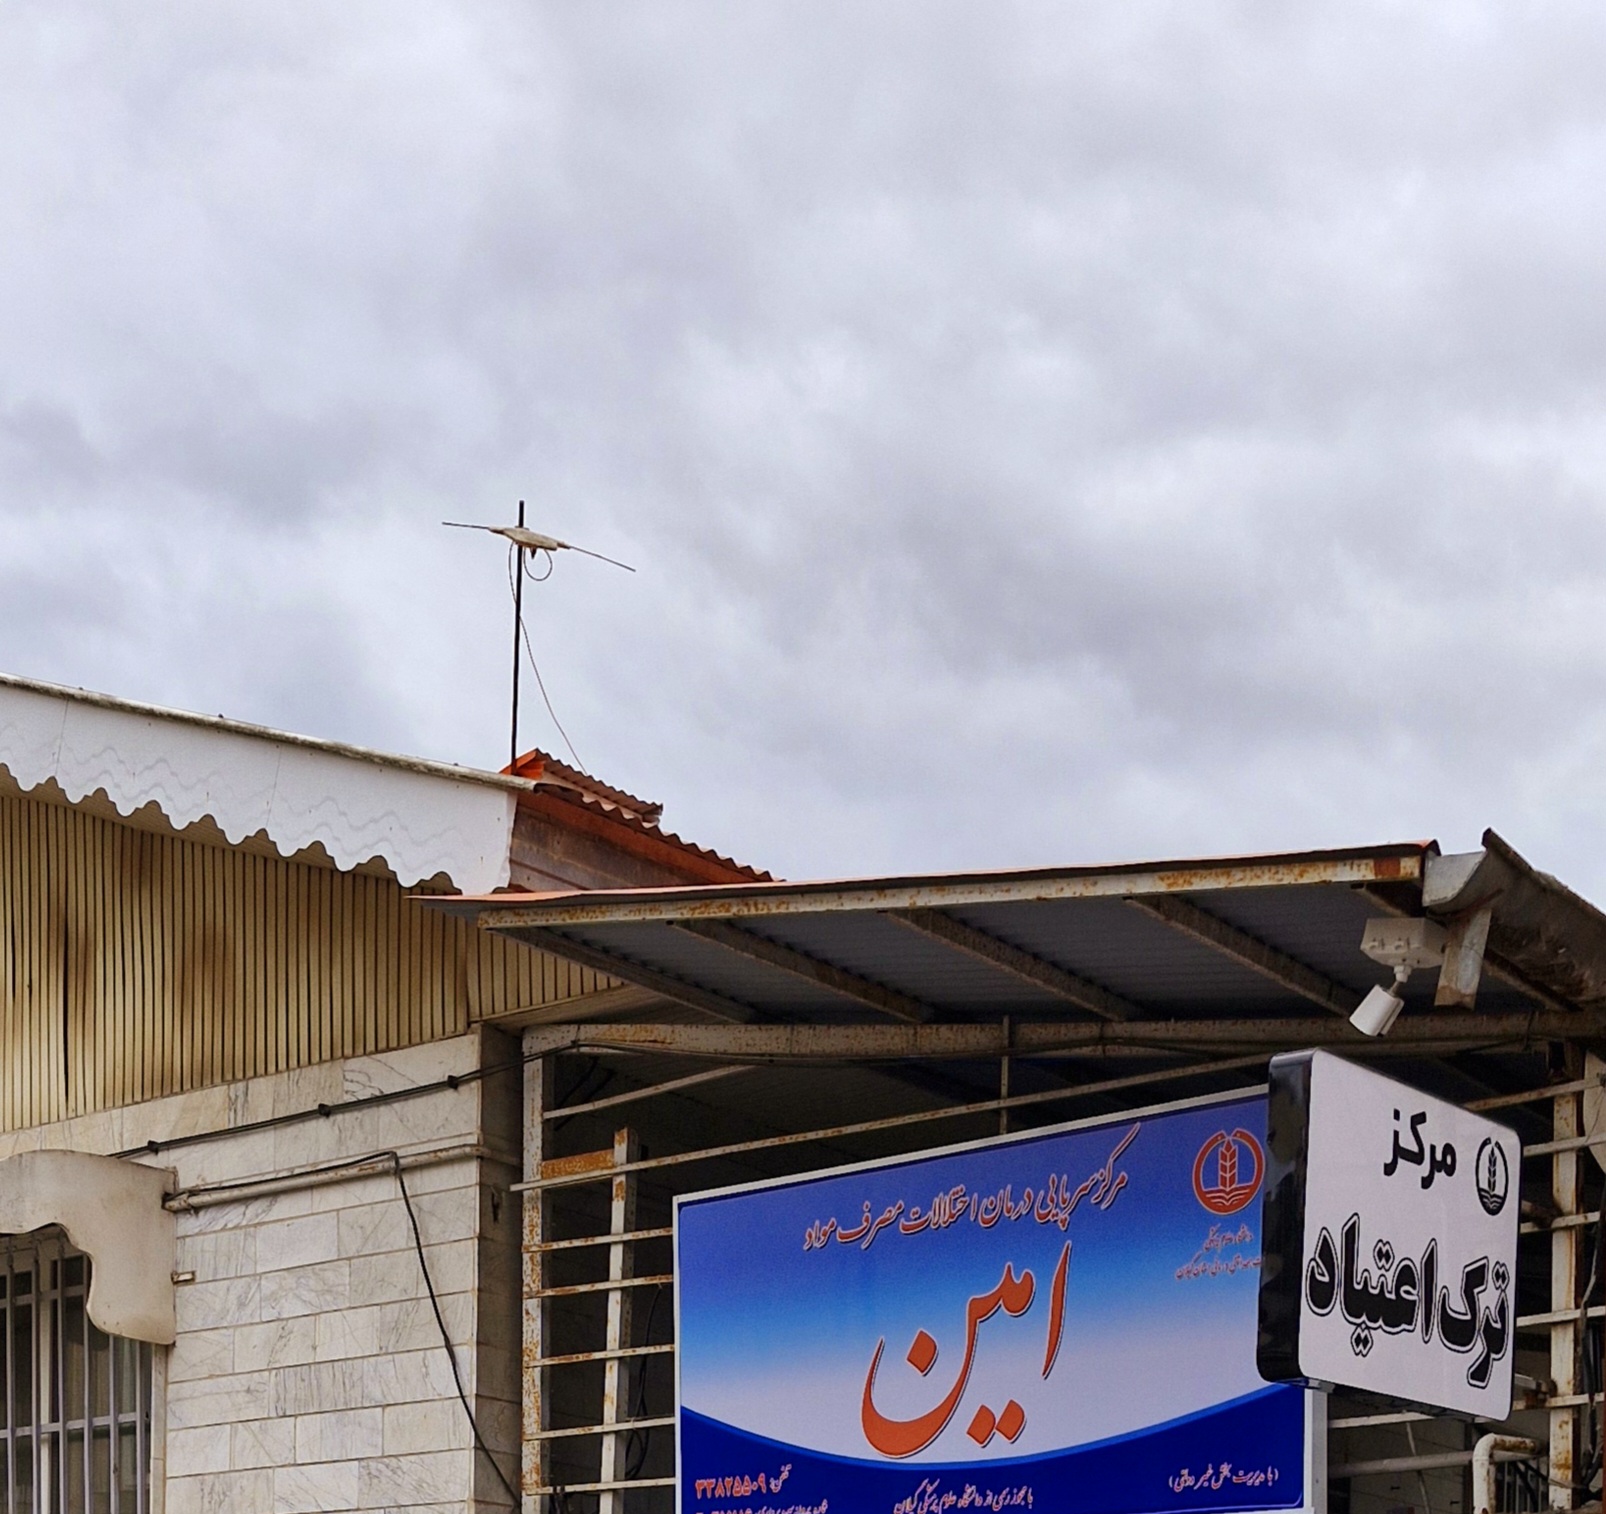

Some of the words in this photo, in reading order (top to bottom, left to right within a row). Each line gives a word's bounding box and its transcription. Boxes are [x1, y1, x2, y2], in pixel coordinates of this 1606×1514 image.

[1090, 1121, 1141, 1210] مرکز
[1383, 1108, 1457, 1190] مرکز
[803, 1217, 836, 1250] مواد
[836, 1200, 904, 1250] مصرف
[899, 1184, 978, 1234] اختلالات
[978, 1184, 1034, 1228] درمان
[1305, 1212, 1438, 1357] اعتیاد
[1437, 1255, 1510, 1388] ترک
[861, 1240, 1073, 1459] امین
